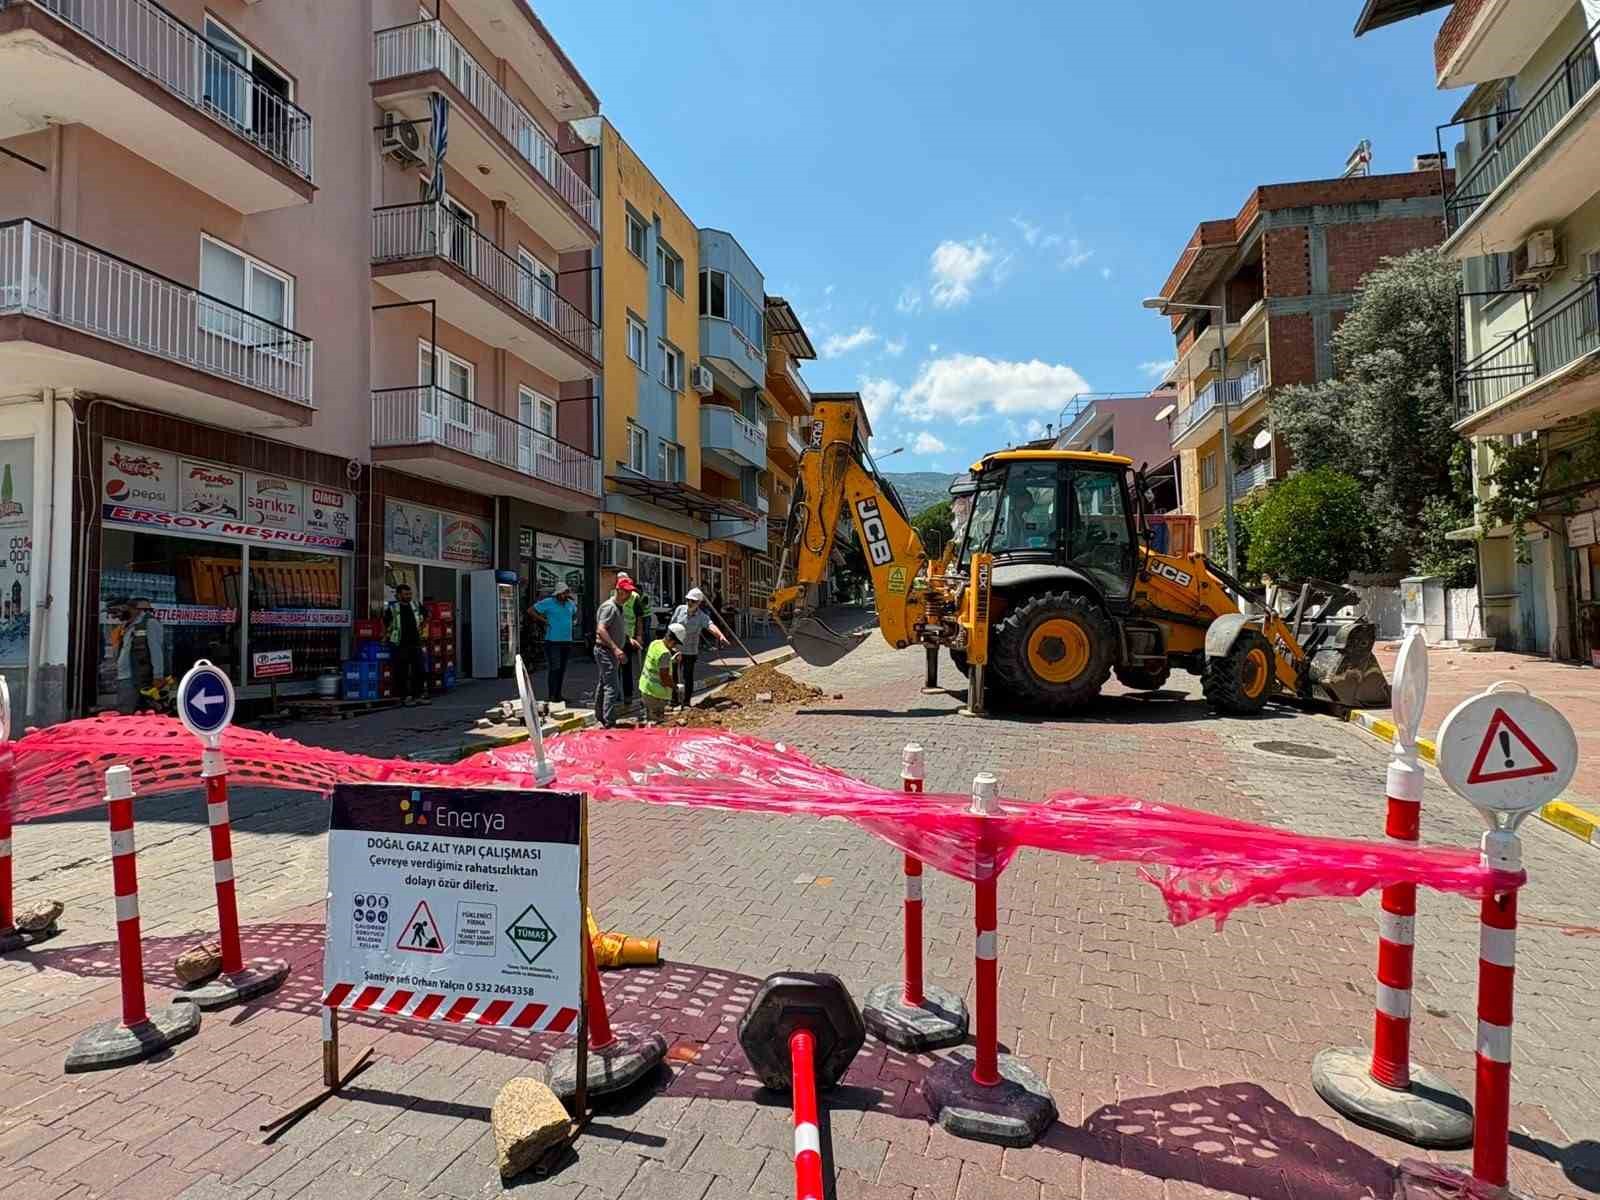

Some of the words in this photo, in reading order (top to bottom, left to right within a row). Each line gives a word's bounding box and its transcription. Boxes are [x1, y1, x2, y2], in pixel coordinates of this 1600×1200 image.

[131, 488, 166, 501] pepsi
[247, 496, 296, 514] sarıkız
[221, 522, 346, 547] MEŞRUBAT
[857, 499, 892, 565] JCB
[1151, 562, 1191, 587] JCB
[436, 806, 505, 834] Enerya
[368, 836, 405, 850] DOĞAL
[406, 840, 430, 852] GAZ
[431, 842, 450, 853] ALT
[452, 844, 476, 857] YAPI
[478, 846, 542, 861] ÇALIŞMASI
[369, 854, 408, 868] Çevreye
[410, 859, 463, 872] verdiğimiz
[465, 862, 539, 877] rahatsızlıktan
[405, 875, 436, 889] dolayı
[438, 878, 461, 889] özür
[462, 880, 499, 893] dileriz.
[517, 928, 546, 941] TÜMAŞ
[364, 970, 395, 984] Şantiye
[396, 975, 411, 985] şefi
[412, 976, 438, 988] Orhan
[439, 979, 465, 992] Yalçın
[466, 982, 473, 991] 0
[475, 983, 493, 993] 532
[494, 984, 535, 996] 2643358
